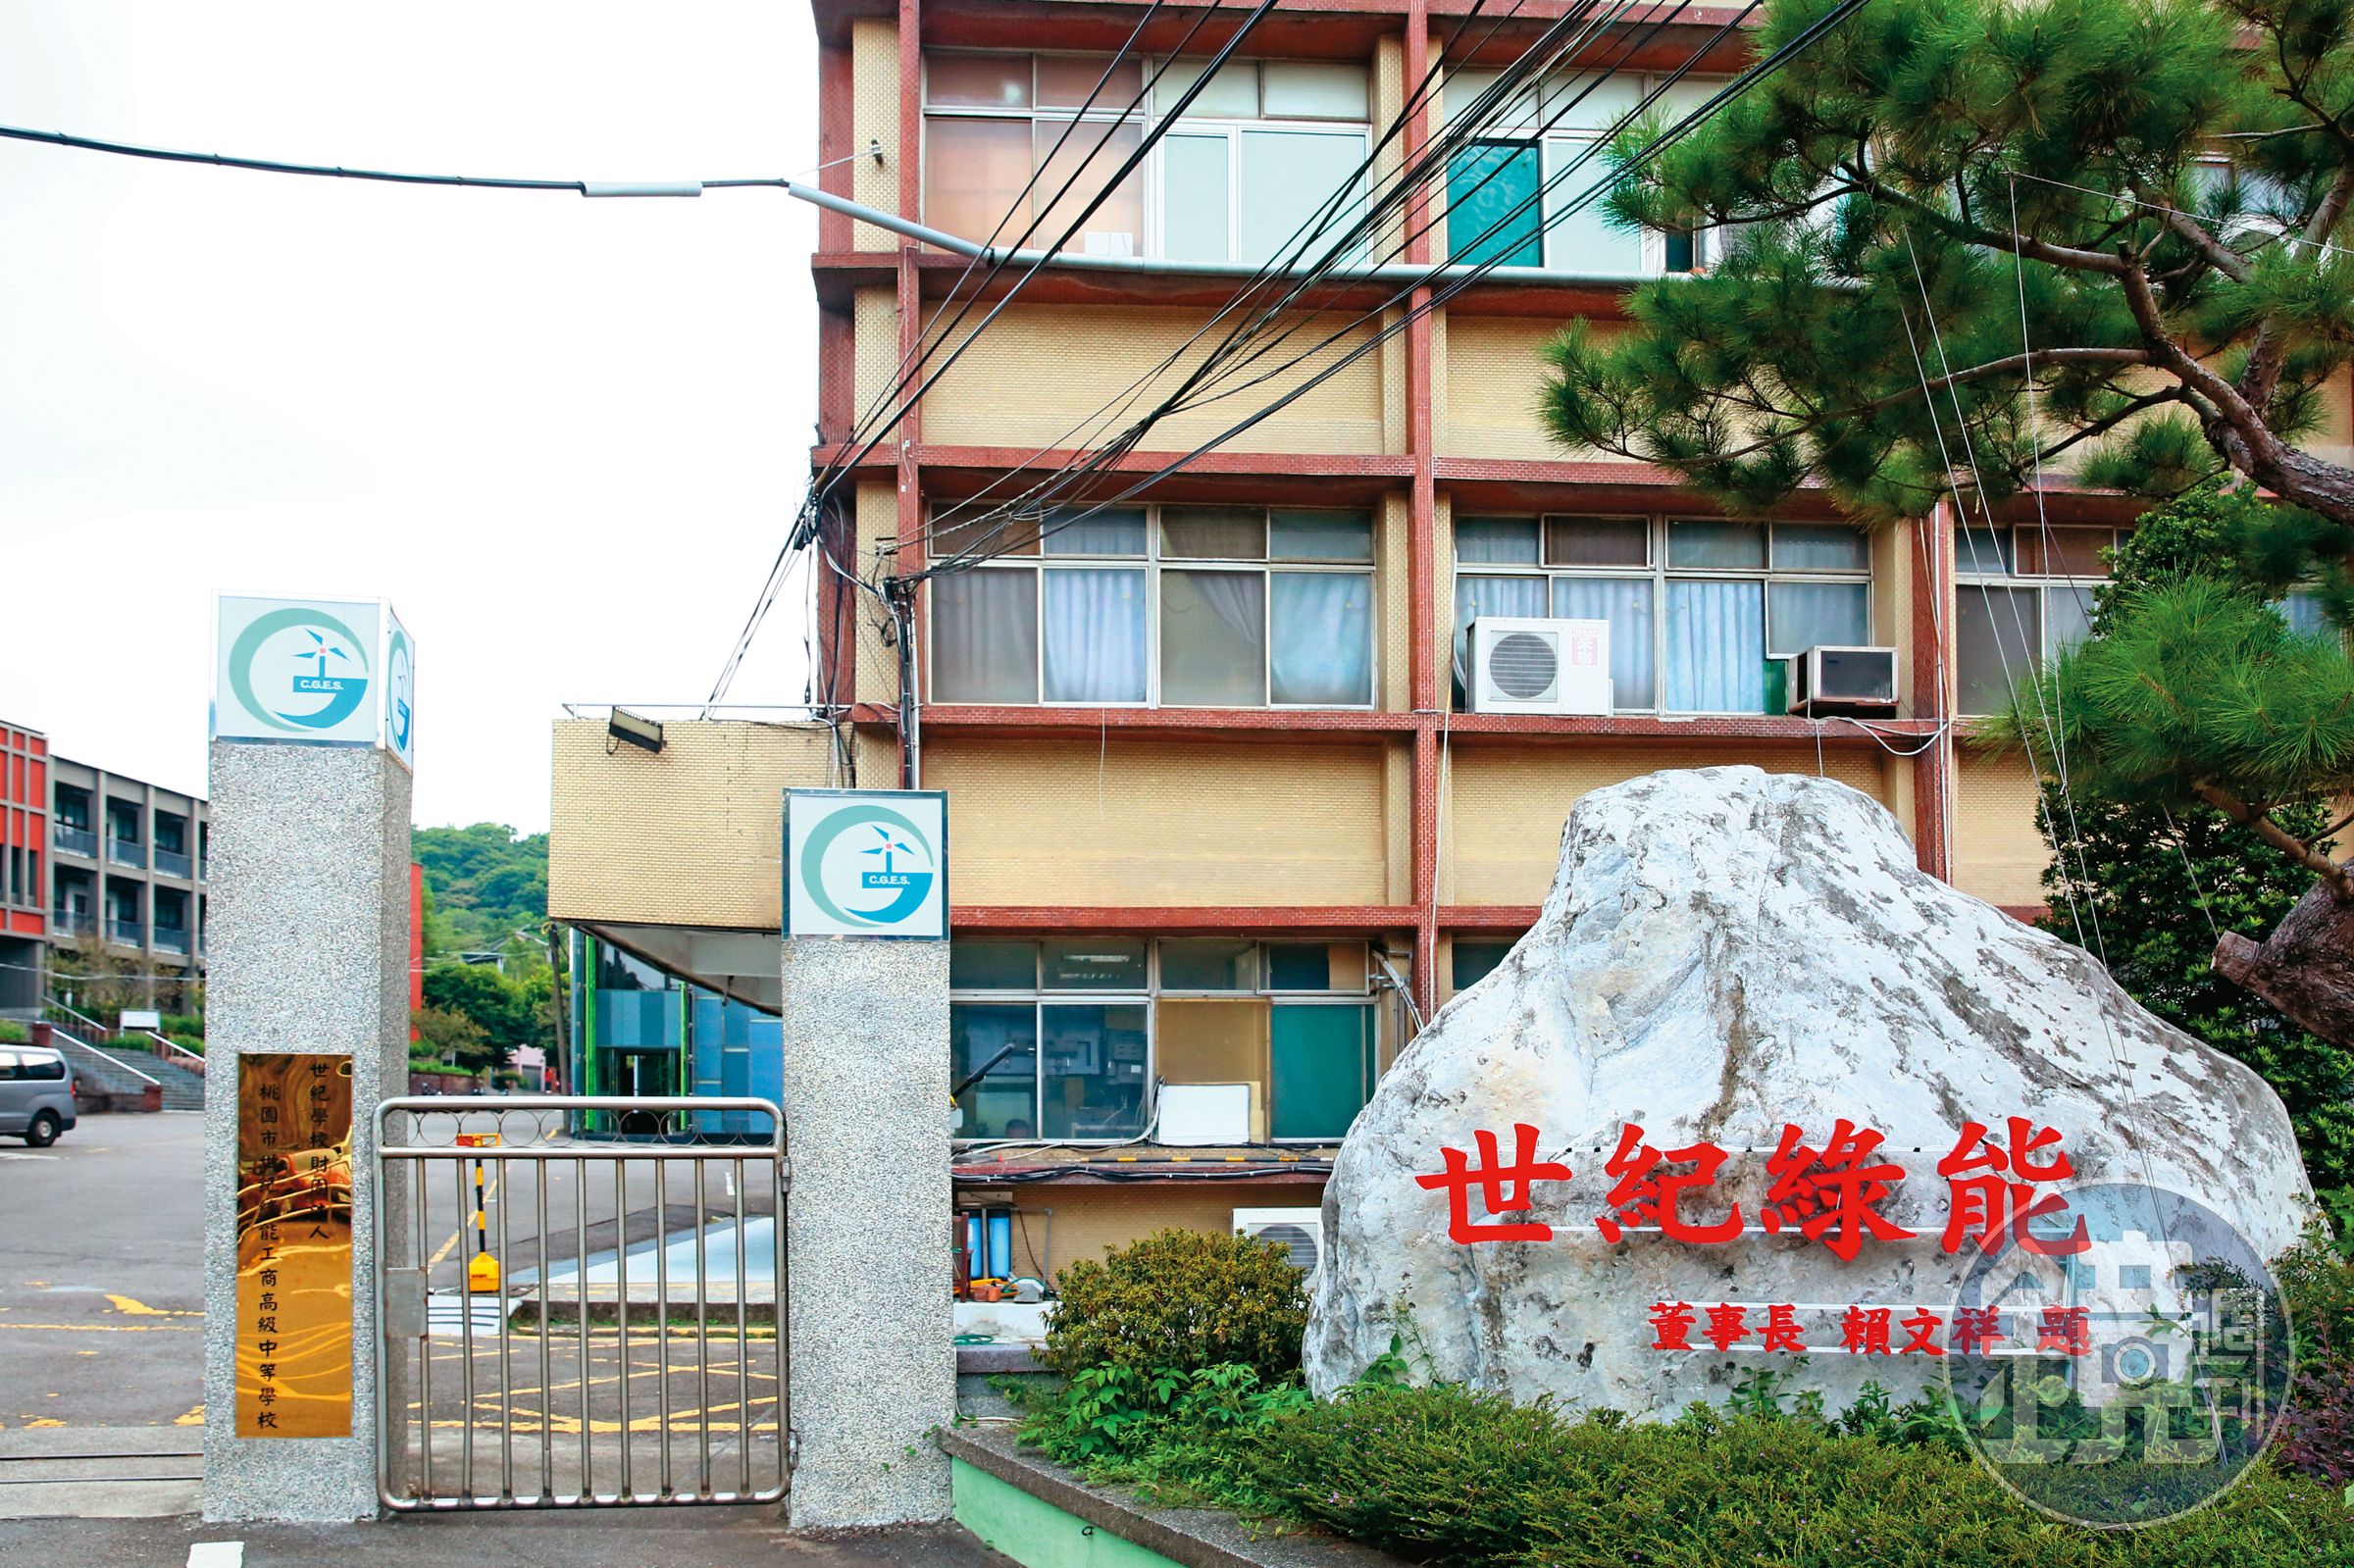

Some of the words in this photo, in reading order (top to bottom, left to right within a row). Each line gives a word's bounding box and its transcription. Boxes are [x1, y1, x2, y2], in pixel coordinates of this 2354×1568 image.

[299, 679, 344, 690] C.G.E.S.
[868, 875, 910, 885] C.G.E.S.
[309, 1062, 331, 1240] 世紀學校財團人
[1414, 1116, 2093, 1263] 世紀綠能
[1648, 1301, 1807, 1353] 董事長
[1839, 1304, 2006, 1357] 賴文祥
[2036, 1305, 2091, 1357] 題
